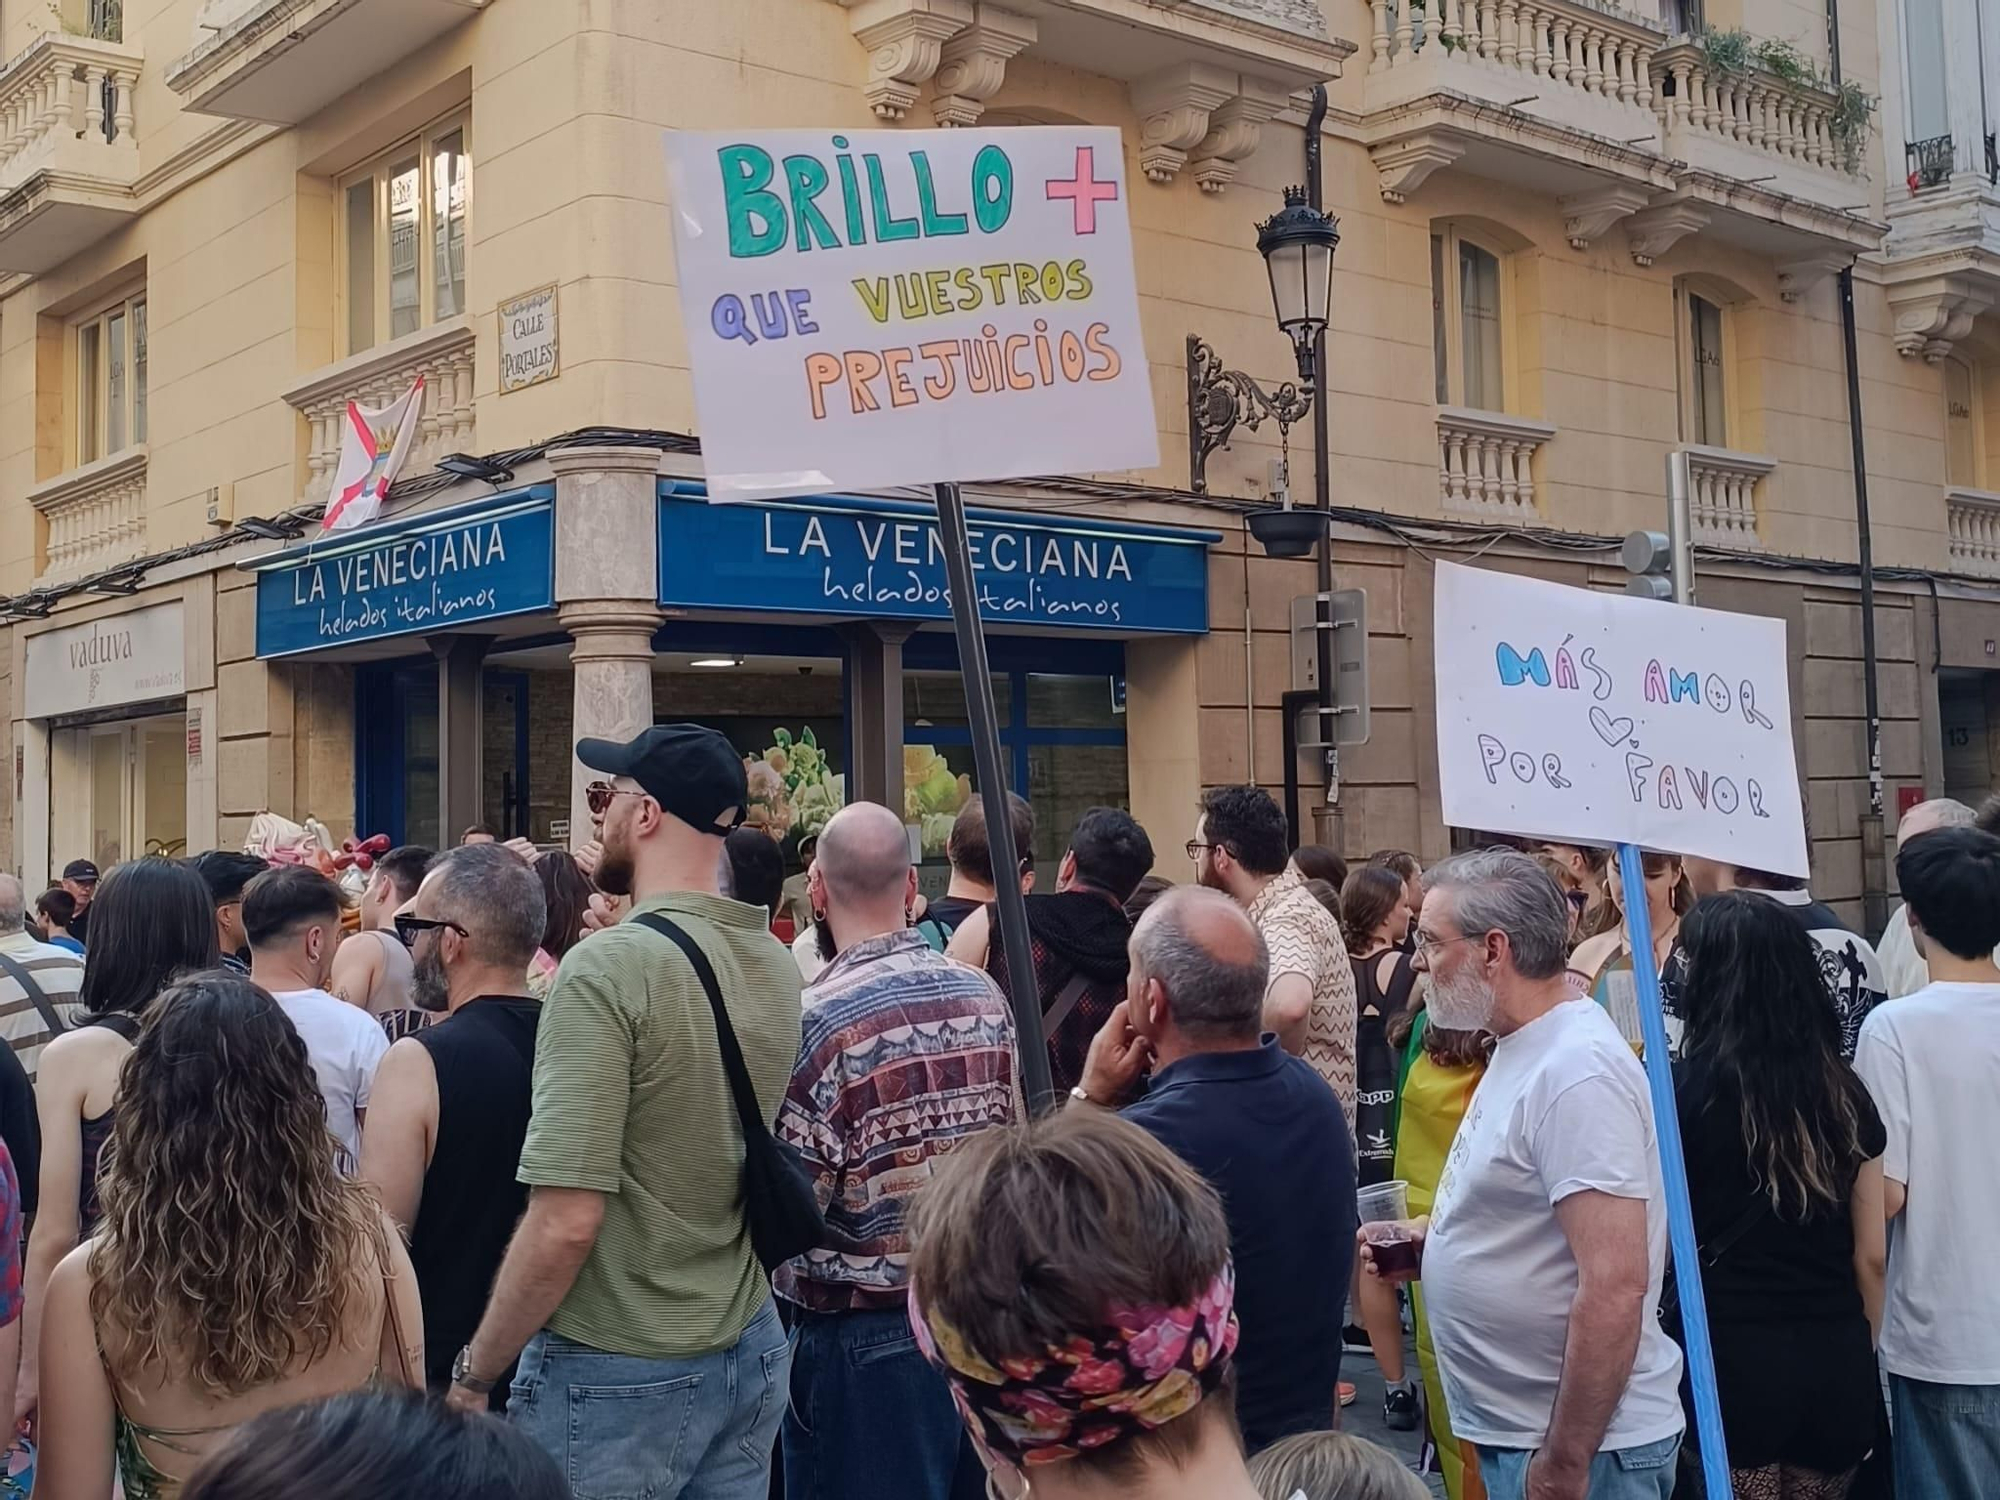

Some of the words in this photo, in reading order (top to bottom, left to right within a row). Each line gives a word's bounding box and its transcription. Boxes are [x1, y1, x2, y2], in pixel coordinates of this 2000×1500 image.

[513, 313, 544, 340] CALLE
[711, 289, 820, 345] QUE
[852, 259, 1093, 323] VUESTROS
[505, 343, 553, 378] PORTALES
[294, 565, 326, 605] LA
[337, 523, 505, 596] VENECIANA
[765, 512, 832, 558] LA
[857, 520, 1132, 582] VENECIANA
[319, 599, 387, 636] helados
[394, 581, 495, 622] italianos
[824, 565, 953, 609] helados
[978, 578, 1121, 622] talianos
[70, 623, 133, 670] vaduva
[1495, 634, 1613, 701] MÁS
[1644, 658, 1774, 730] AMOR
[1948, 727, 1969, 747] 13
[1478, 734, 1572, 789] POR
[1625, 751, 1771, 818] FAVOR
